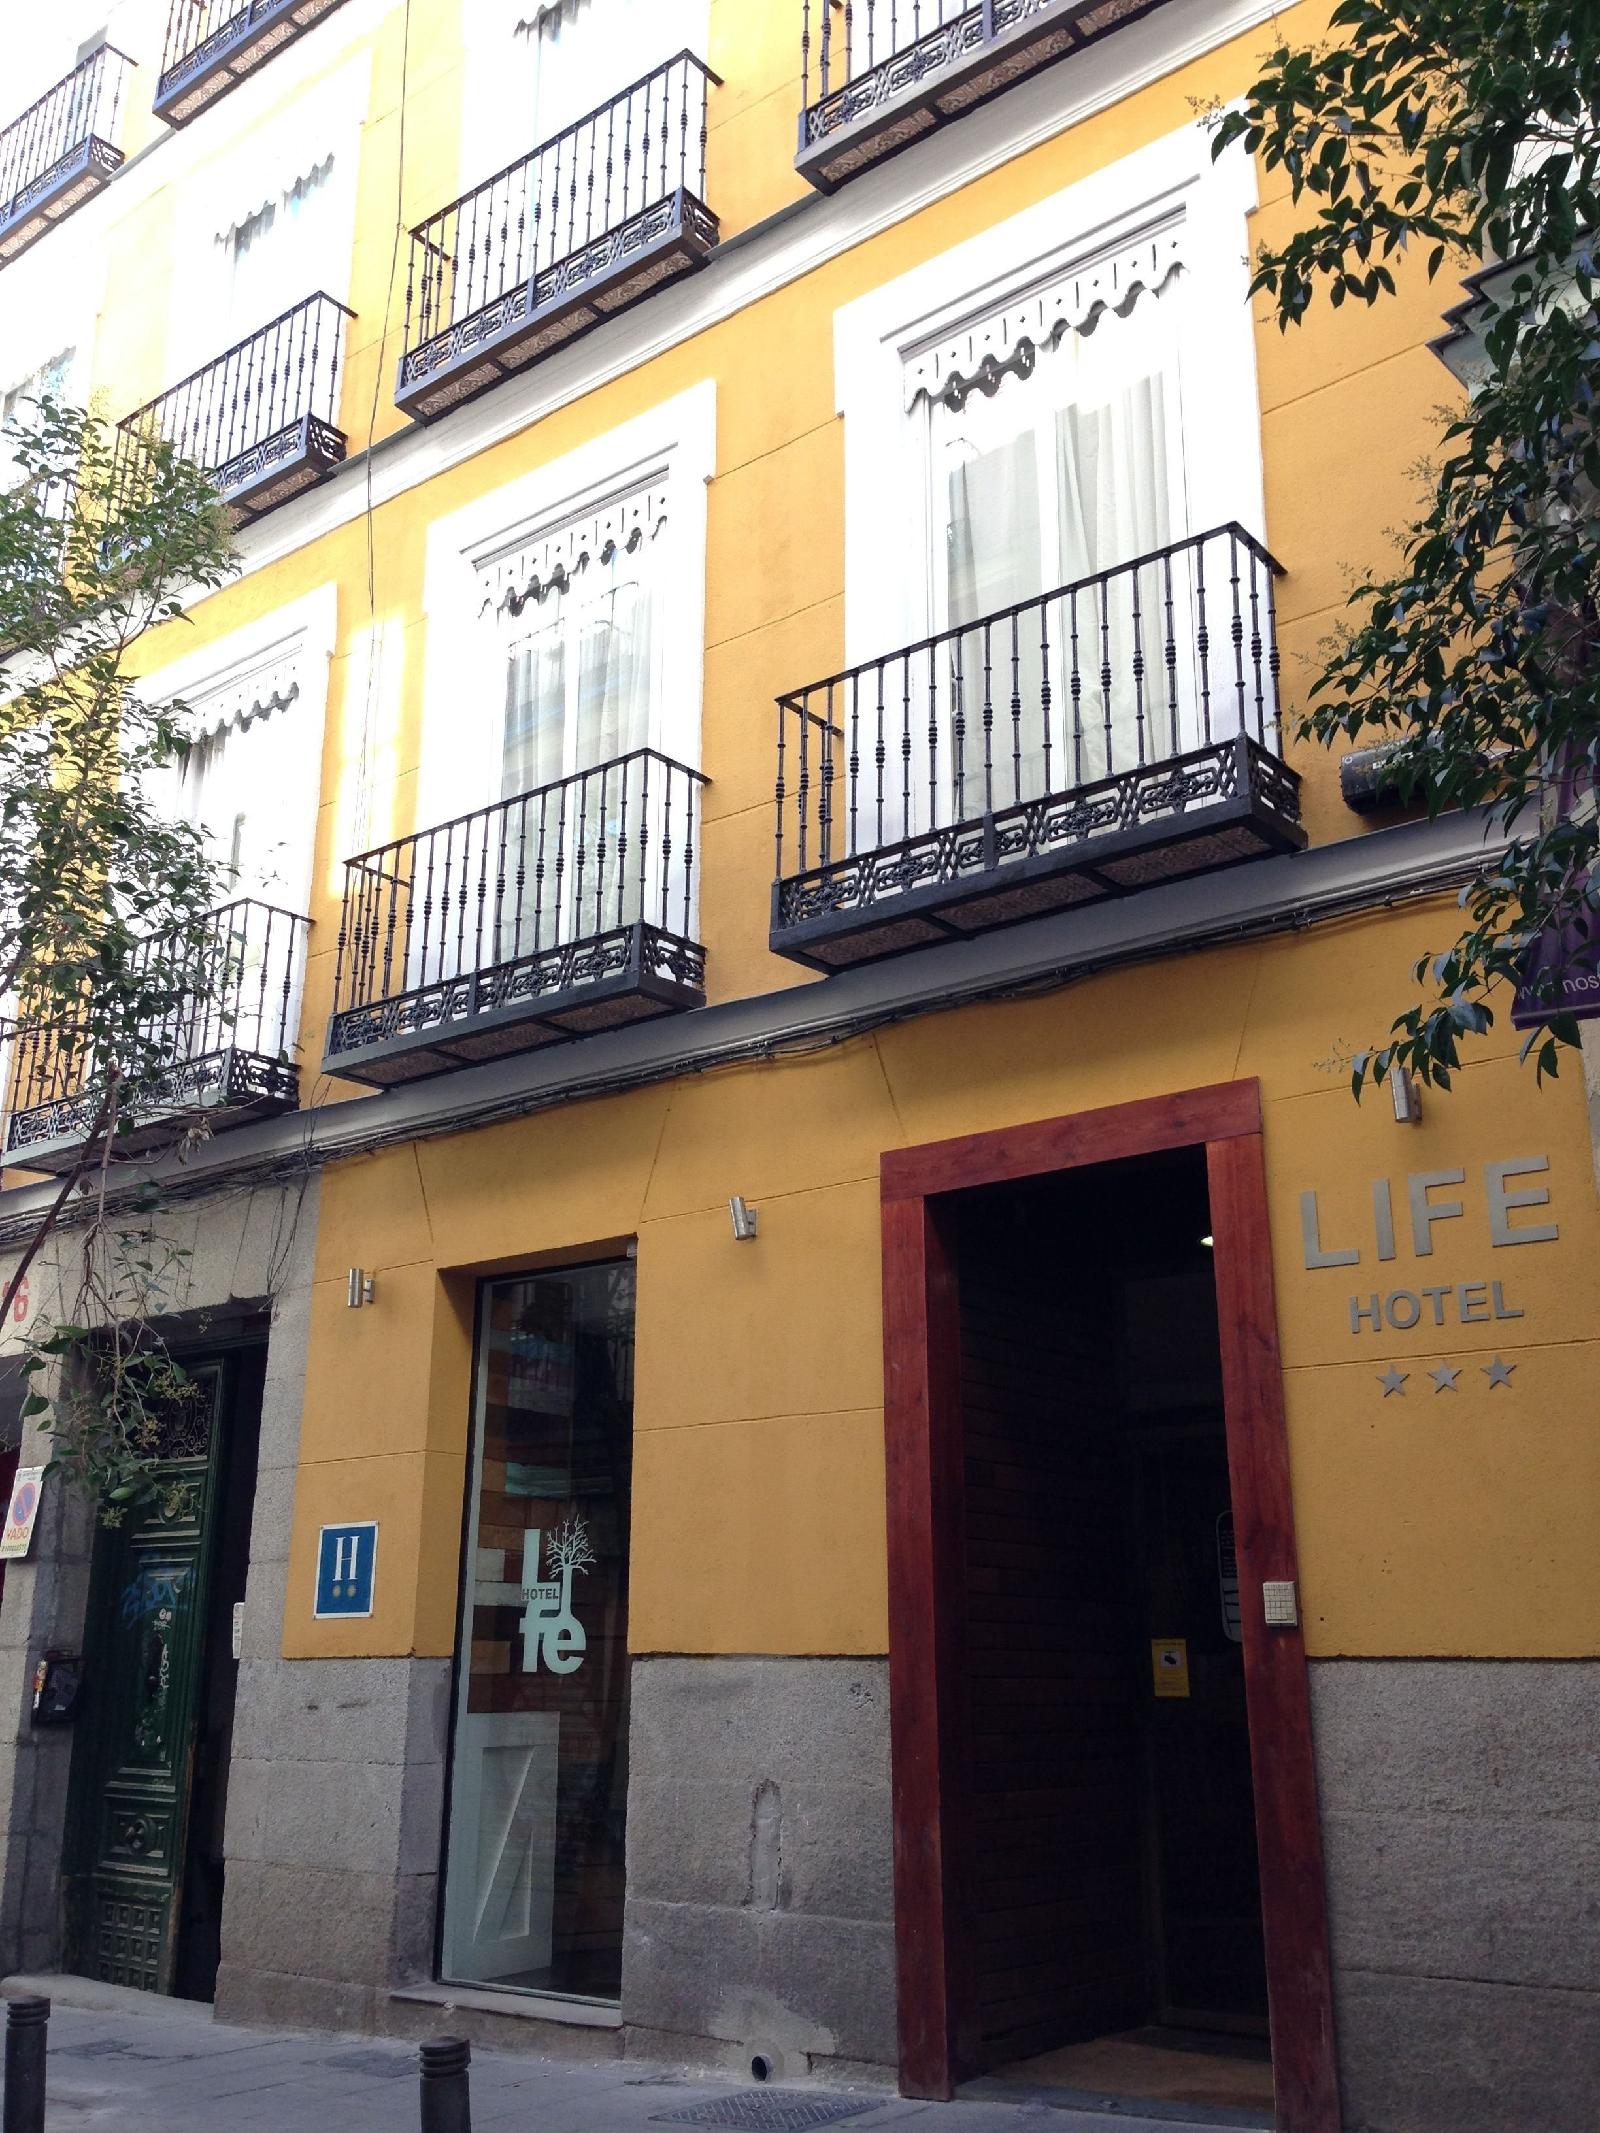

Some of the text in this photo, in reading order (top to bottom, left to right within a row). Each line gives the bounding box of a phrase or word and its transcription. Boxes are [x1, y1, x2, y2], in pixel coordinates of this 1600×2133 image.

[1300, 1155, 1559, 1270] LIFE
[1349, 1280, 1525, 1334] HOTEL
[332, 1535, 360, 1582] H
[520, 1588, 559, 1600] HOTEL
